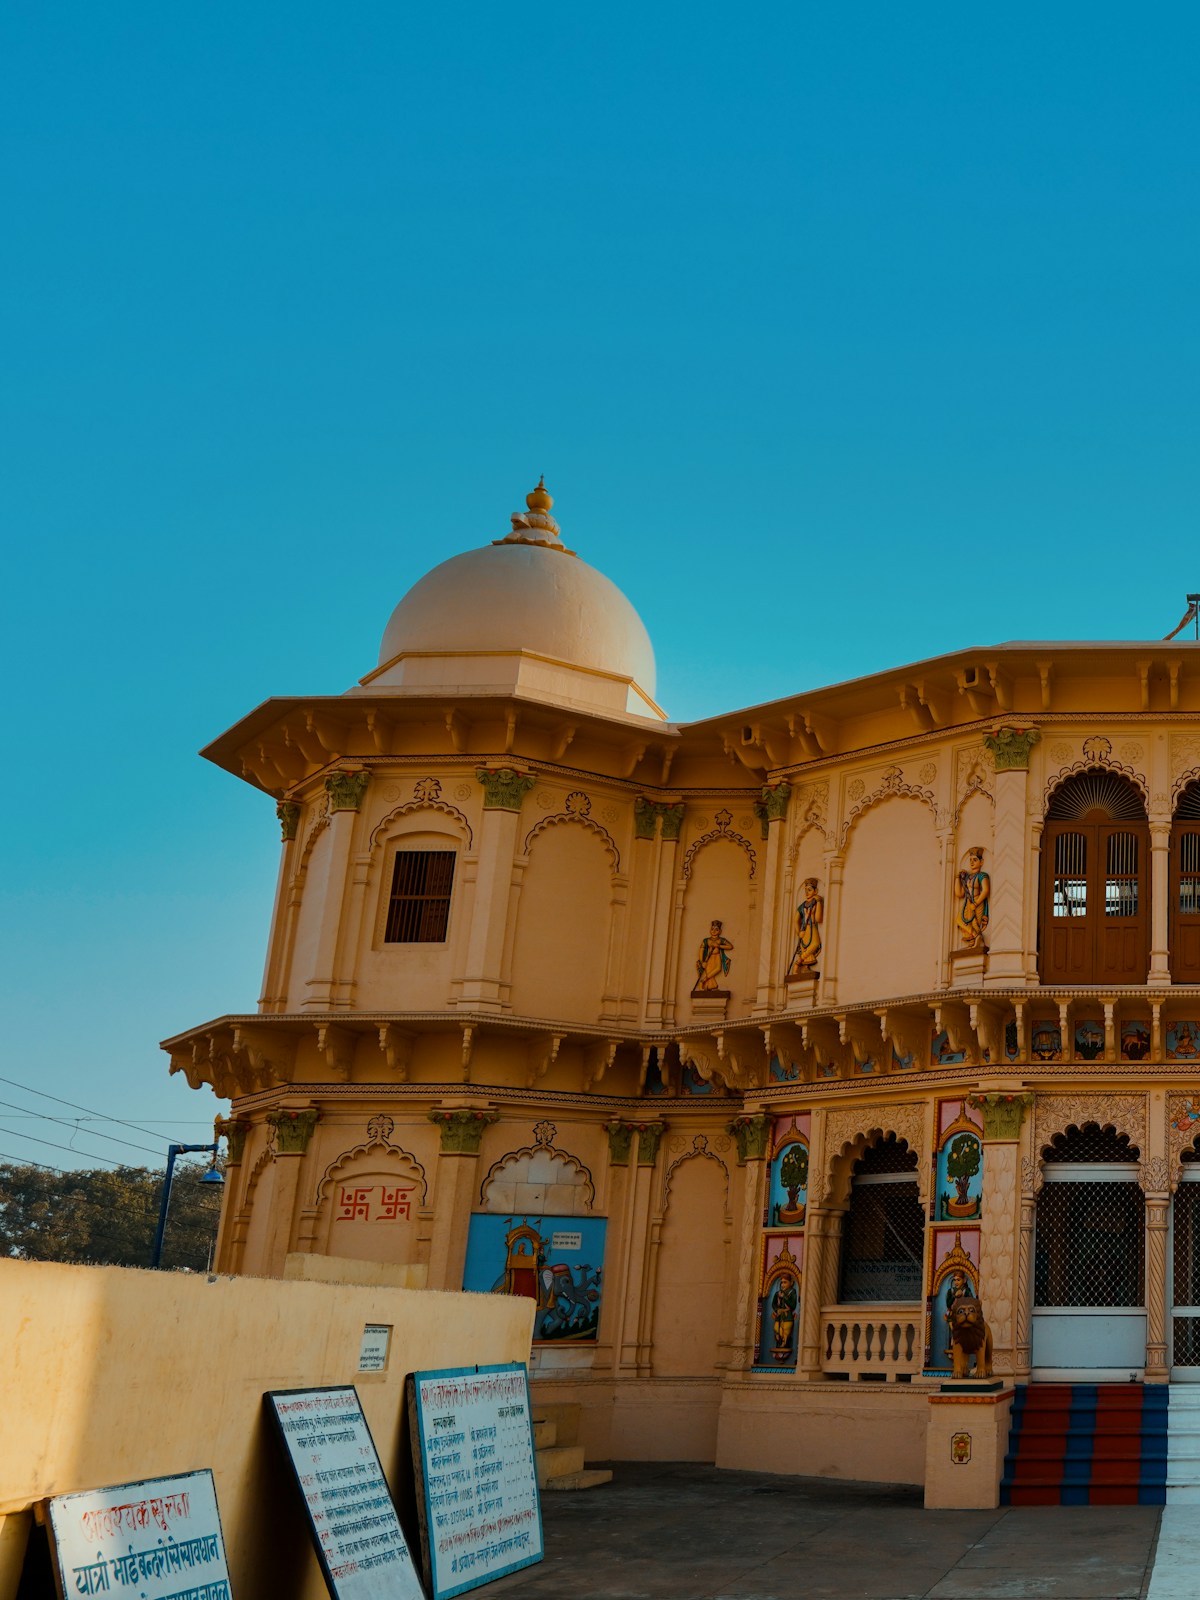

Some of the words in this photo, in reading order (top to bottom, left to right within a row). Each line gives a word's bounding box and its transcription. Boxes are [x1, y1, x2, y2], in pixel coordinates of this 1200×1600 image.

[72, 1550, 110, 1596] यात्री
[110, 1543, 139, 1587] भाई
[179, 1533, 220, 1571] सावधान
